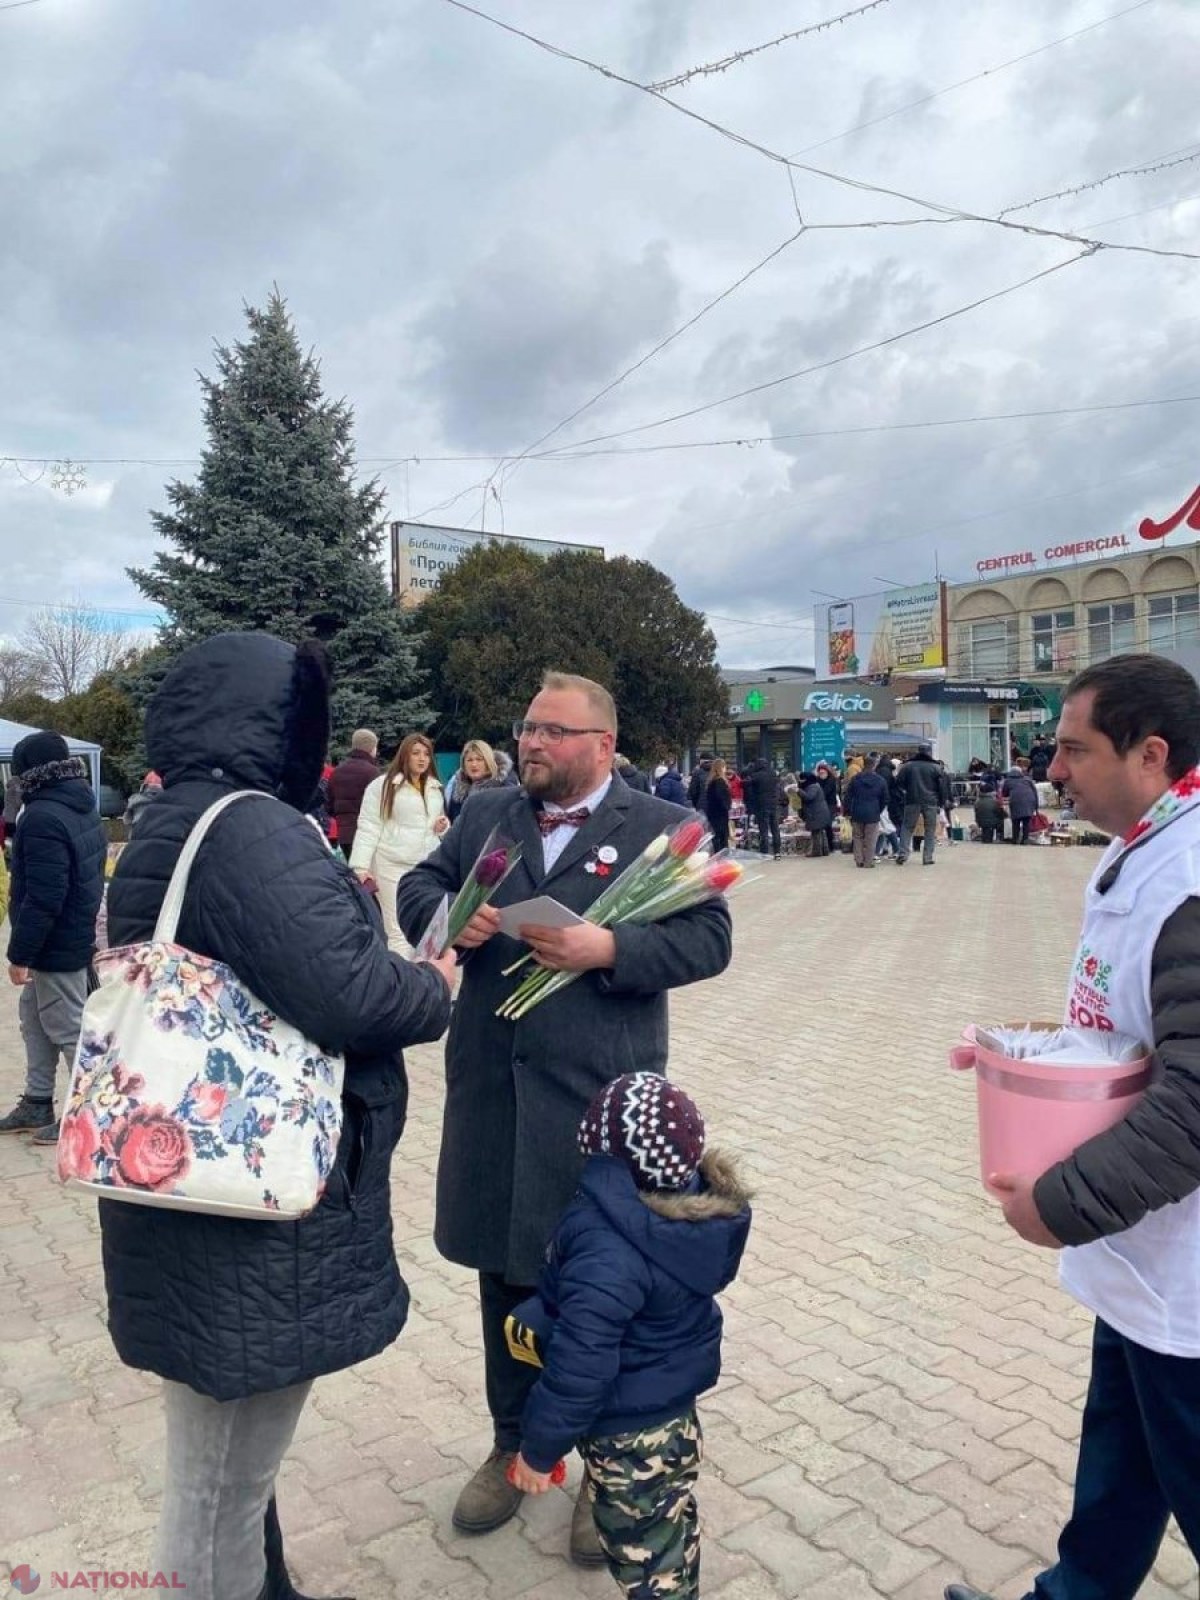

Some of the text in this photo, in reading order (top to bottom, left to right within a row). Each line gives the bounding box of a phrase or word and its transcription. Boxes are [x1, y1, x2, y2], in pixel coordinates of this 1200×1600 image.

[408, 537, 447, 552] Библия
[976, 534, 1130, 572] CENTRUL COMERCIAL
[803, 692, 873, 712] Felicia
